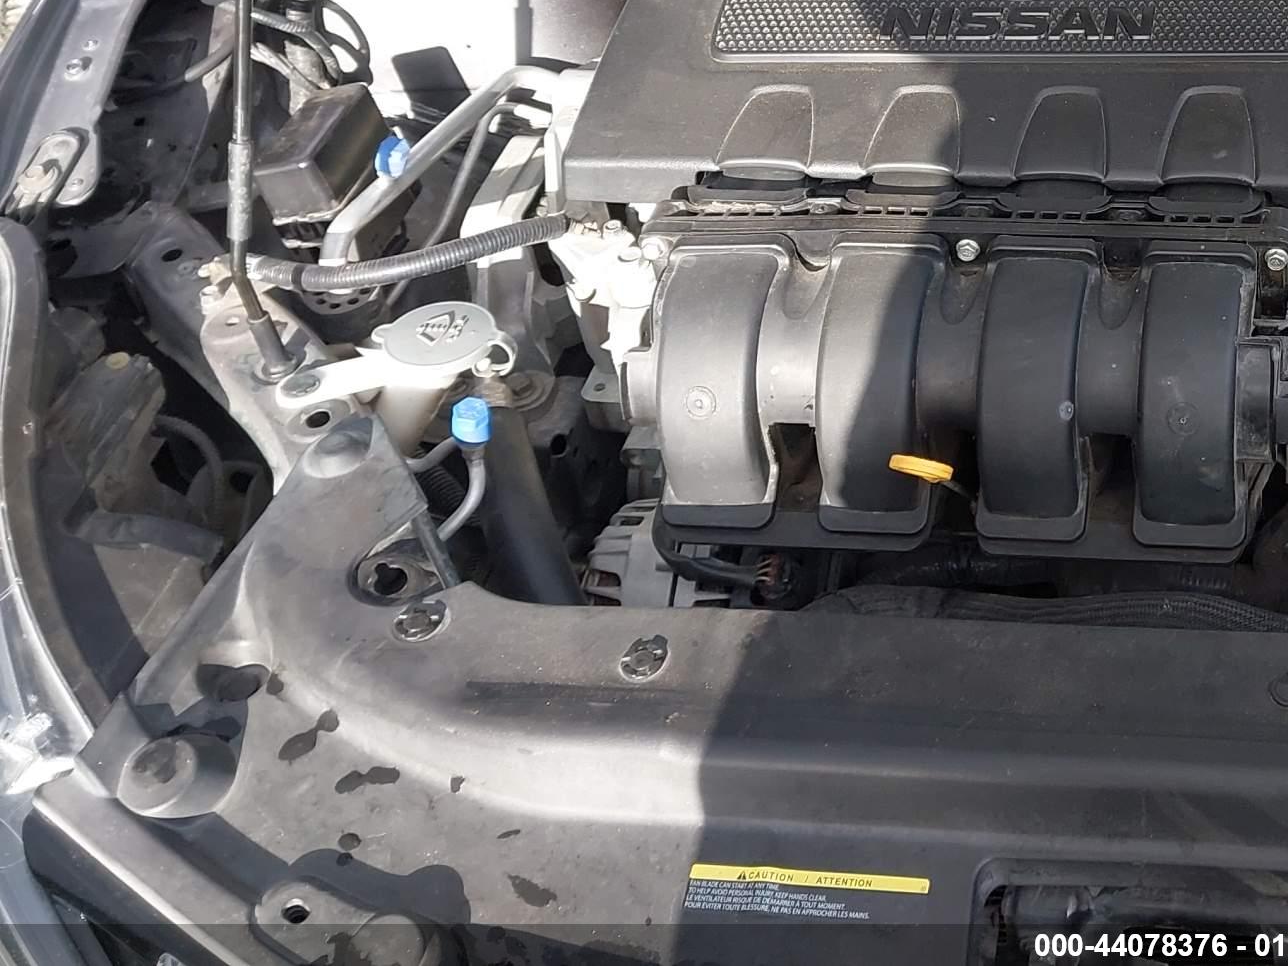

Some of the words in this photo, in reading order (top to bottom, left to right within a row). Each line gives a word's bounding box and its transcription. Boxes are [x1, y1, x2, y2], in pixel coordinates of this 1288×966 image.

[880, 7, 1154, 40] NISSAN
[748, 871, 794, 882] CAUTION
[815, 876, 873, 887] ATTENTION
